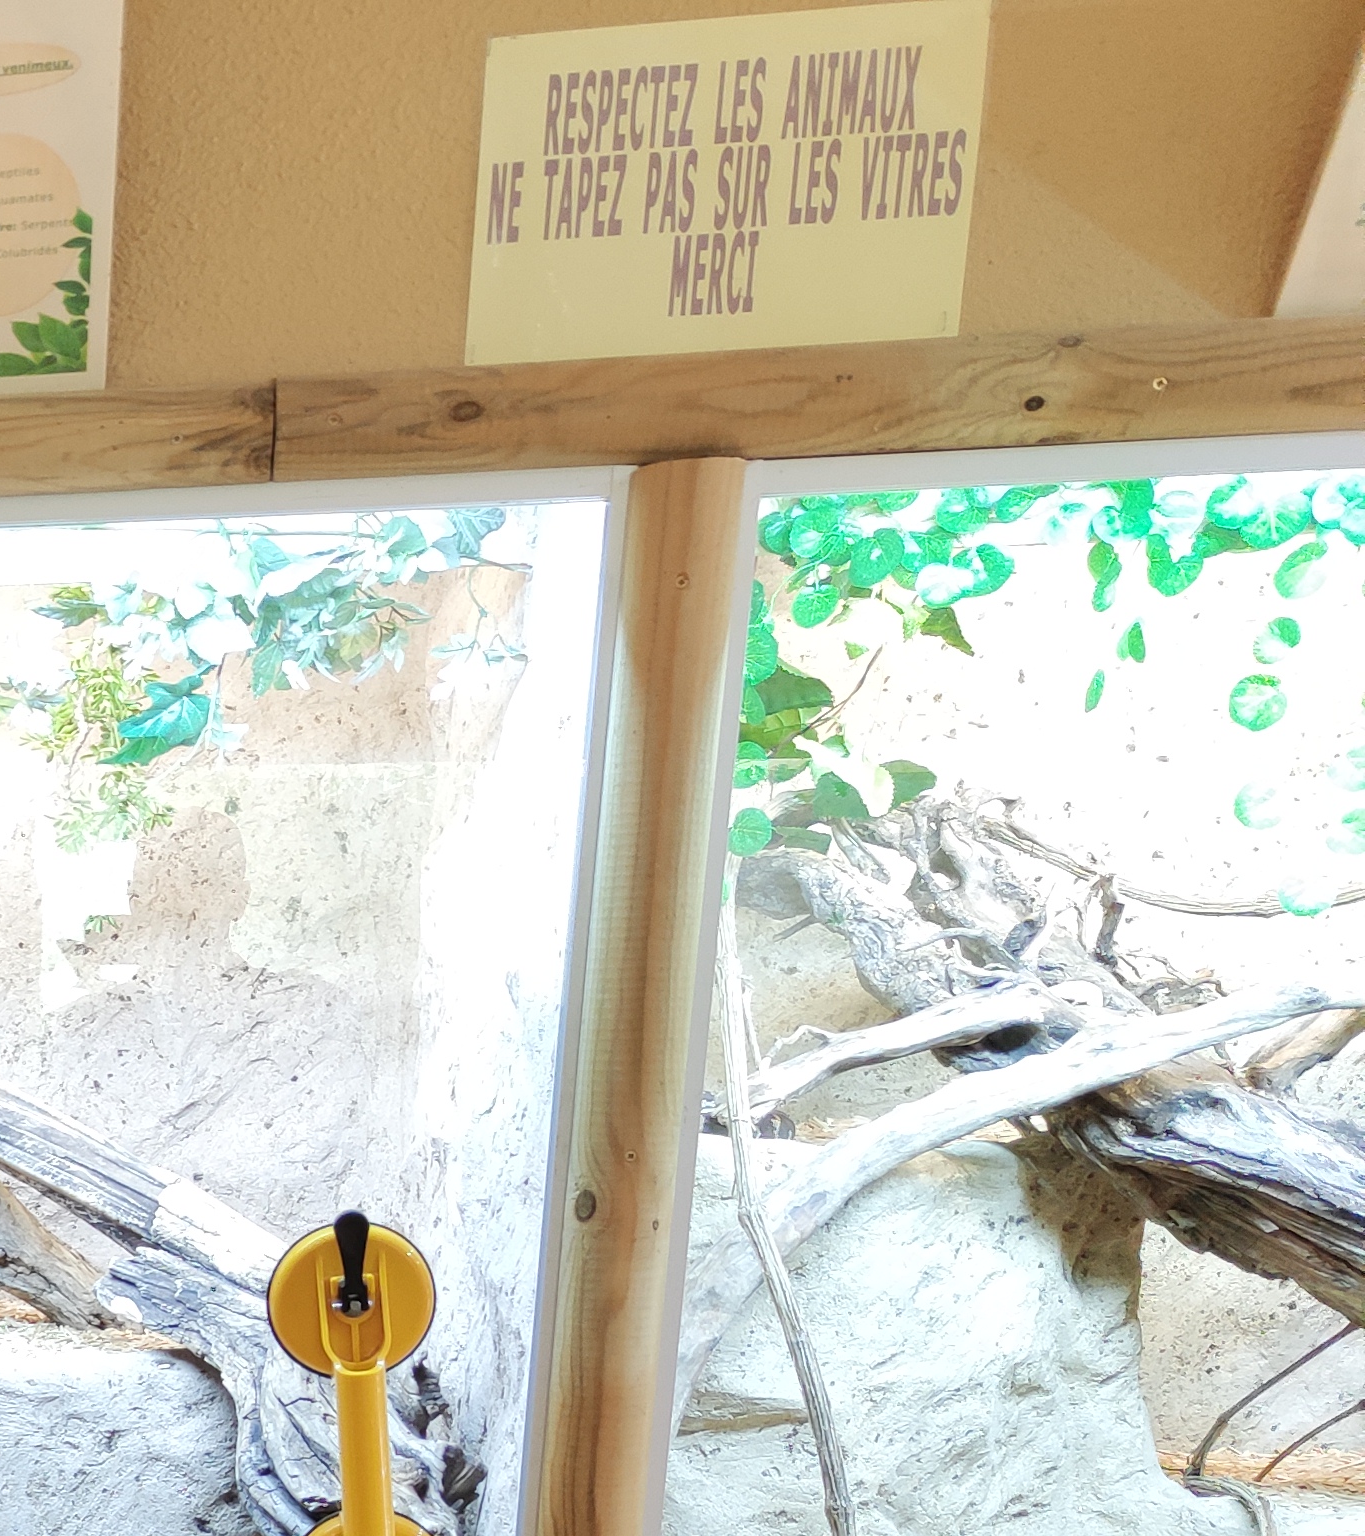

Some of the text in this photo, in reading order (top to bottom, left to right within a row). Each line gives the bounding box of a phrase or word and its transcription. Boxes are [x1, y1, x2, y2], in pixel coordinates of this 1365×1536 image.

[2, 59, 74, 75] venimeux.
[543, 45, 923, 157] RESPECTEZ LES ANIMAUX
[487, 128, 967, 245] NE TAPEZ PAS SUR LES VITRES
[667, 230, 759, 317] MERCI
